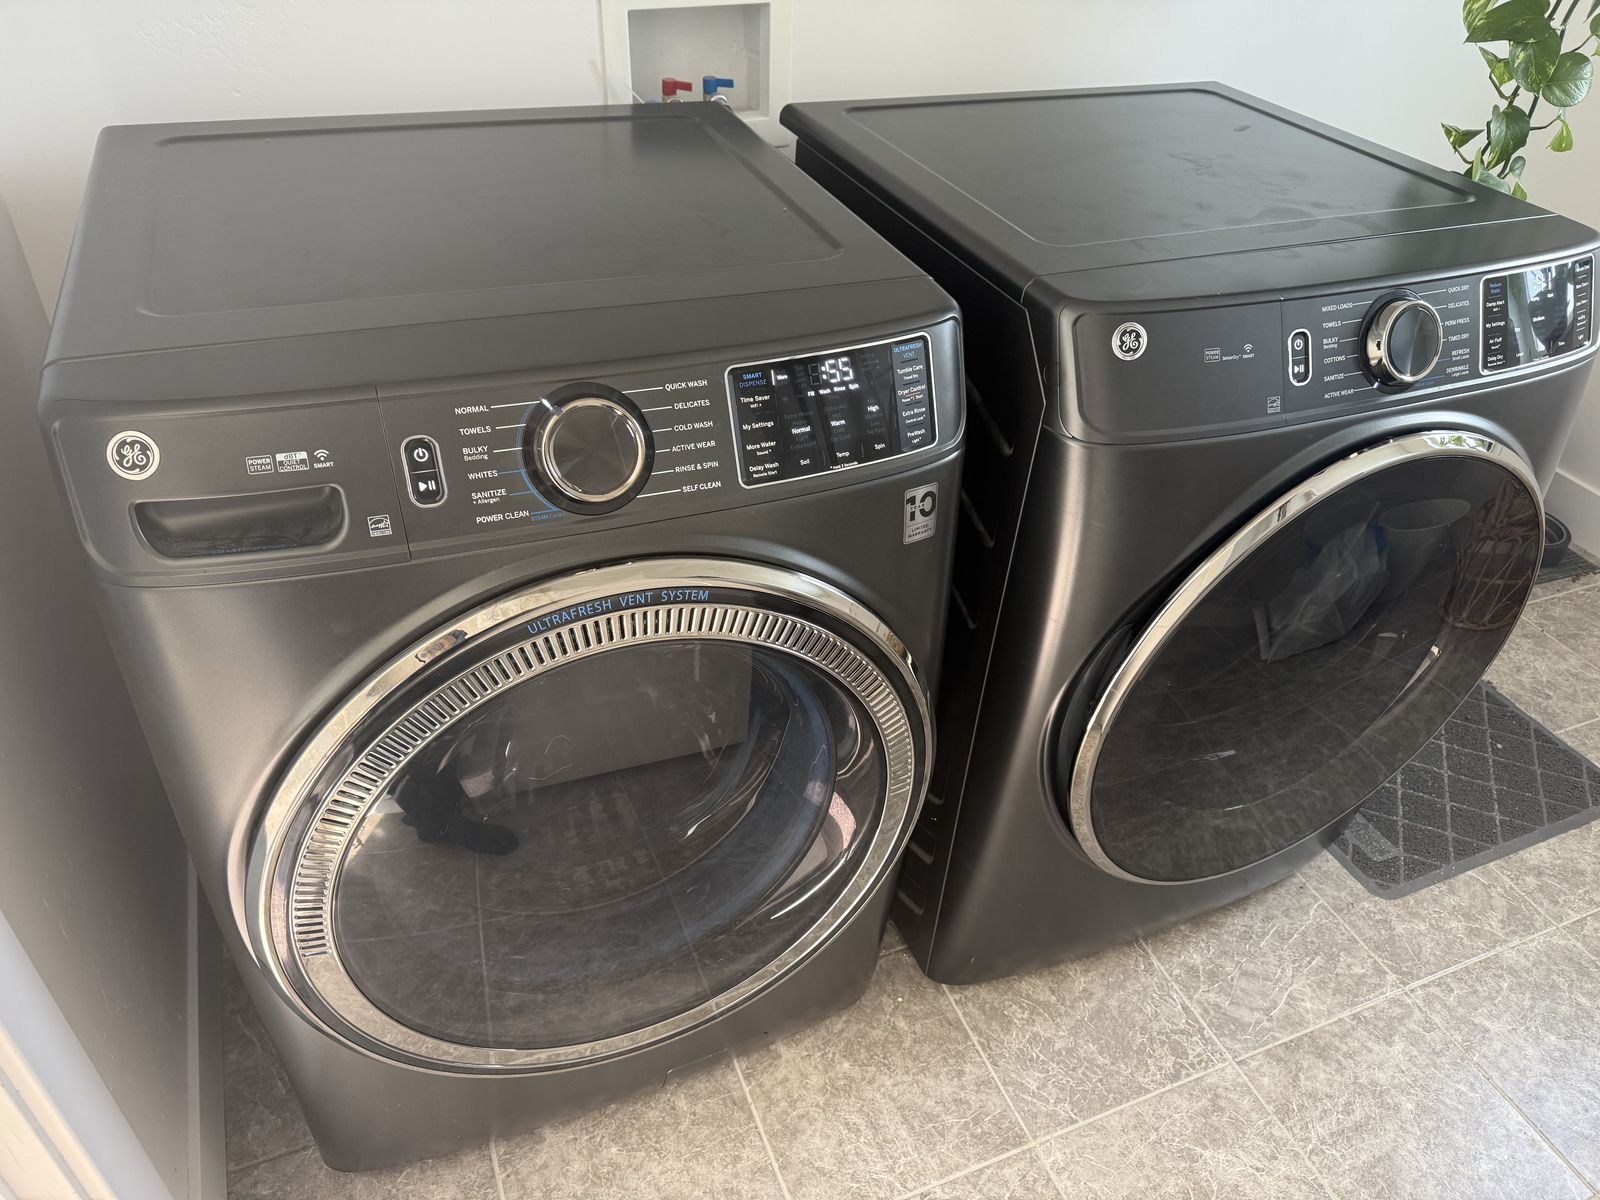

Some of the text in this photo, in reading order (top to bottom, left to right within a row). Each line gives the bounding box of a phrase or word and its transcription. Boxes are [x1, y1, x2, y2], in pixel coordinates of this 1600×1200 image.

[1447, 286, 1461, 294] QUICK
[1321, 302, 1353, 312] MIXED LOADS
[1322, 320, 1341, 329] TOWELS
[1456, 317, 1470, 325] PRESS
[1322, 336, 1338, 345] BULKY
[893, 342, 923, 353] ULTRAFRESH
[1451, 348, 1470, 356] REFRESH
[1323, 354, 1346, 364] COTTONS
[742, 372, 763, 380] SMART
[896, 367, 913, 375] Tumble
[1323, 373, 1345, 382] SANITIZE
[664, 379, 708, 392] QUICK WASH
[739, 379, 768, 388] DISPENSE
[909, 384, 926, 392] Control
[1324, 388, 1354, 399] ACTIVE WEAR
[740, 394, 771, 404] Time Saver
[674, 399, 711, 410] DELICATES
[867, 404, 880, 413] High
[454, 405, 490, 415] NORMAL
[673, 420, 714, 432] COLD WASH
[752, 420, 775, 430] Settings
[830, 419, 846, 427] Warm
[460, 425, 492, 436] TOWELS
[791, 425, 811, 435] Normal
[462, 445, 489, 455] BULKY
[671, 440, 716, 453] ACTIVE WEAR
[760, 441, 777, 449] Water
[464, 453, 489, 462] Bedding
[835, 451, 850, 459] Temp
[314, 461, 334, 469] SMART
[675, 464, 696, 474] RINSE
[702, 460, 719, 469] SPIN
[749, 461, 780, 473] Delay Wash
[799, 458, 811, 466] Soil
[250, 464, 272, 472] STEAM
[280, 464, 306, 472] CONTROL
[467, 470, 498, 480] WHITES
[682, 480, 722, 494] SELF CLEAN
[471, 488, 508, 500] SANITIZE
[477, 497, 501, 505] Allergen
[906, 490, 937, 522] 10
[476, 510, 530, 524] POWER CLEAN
[527, 590, 709, 634] ULTRAFRESH VENT SYSTEM
